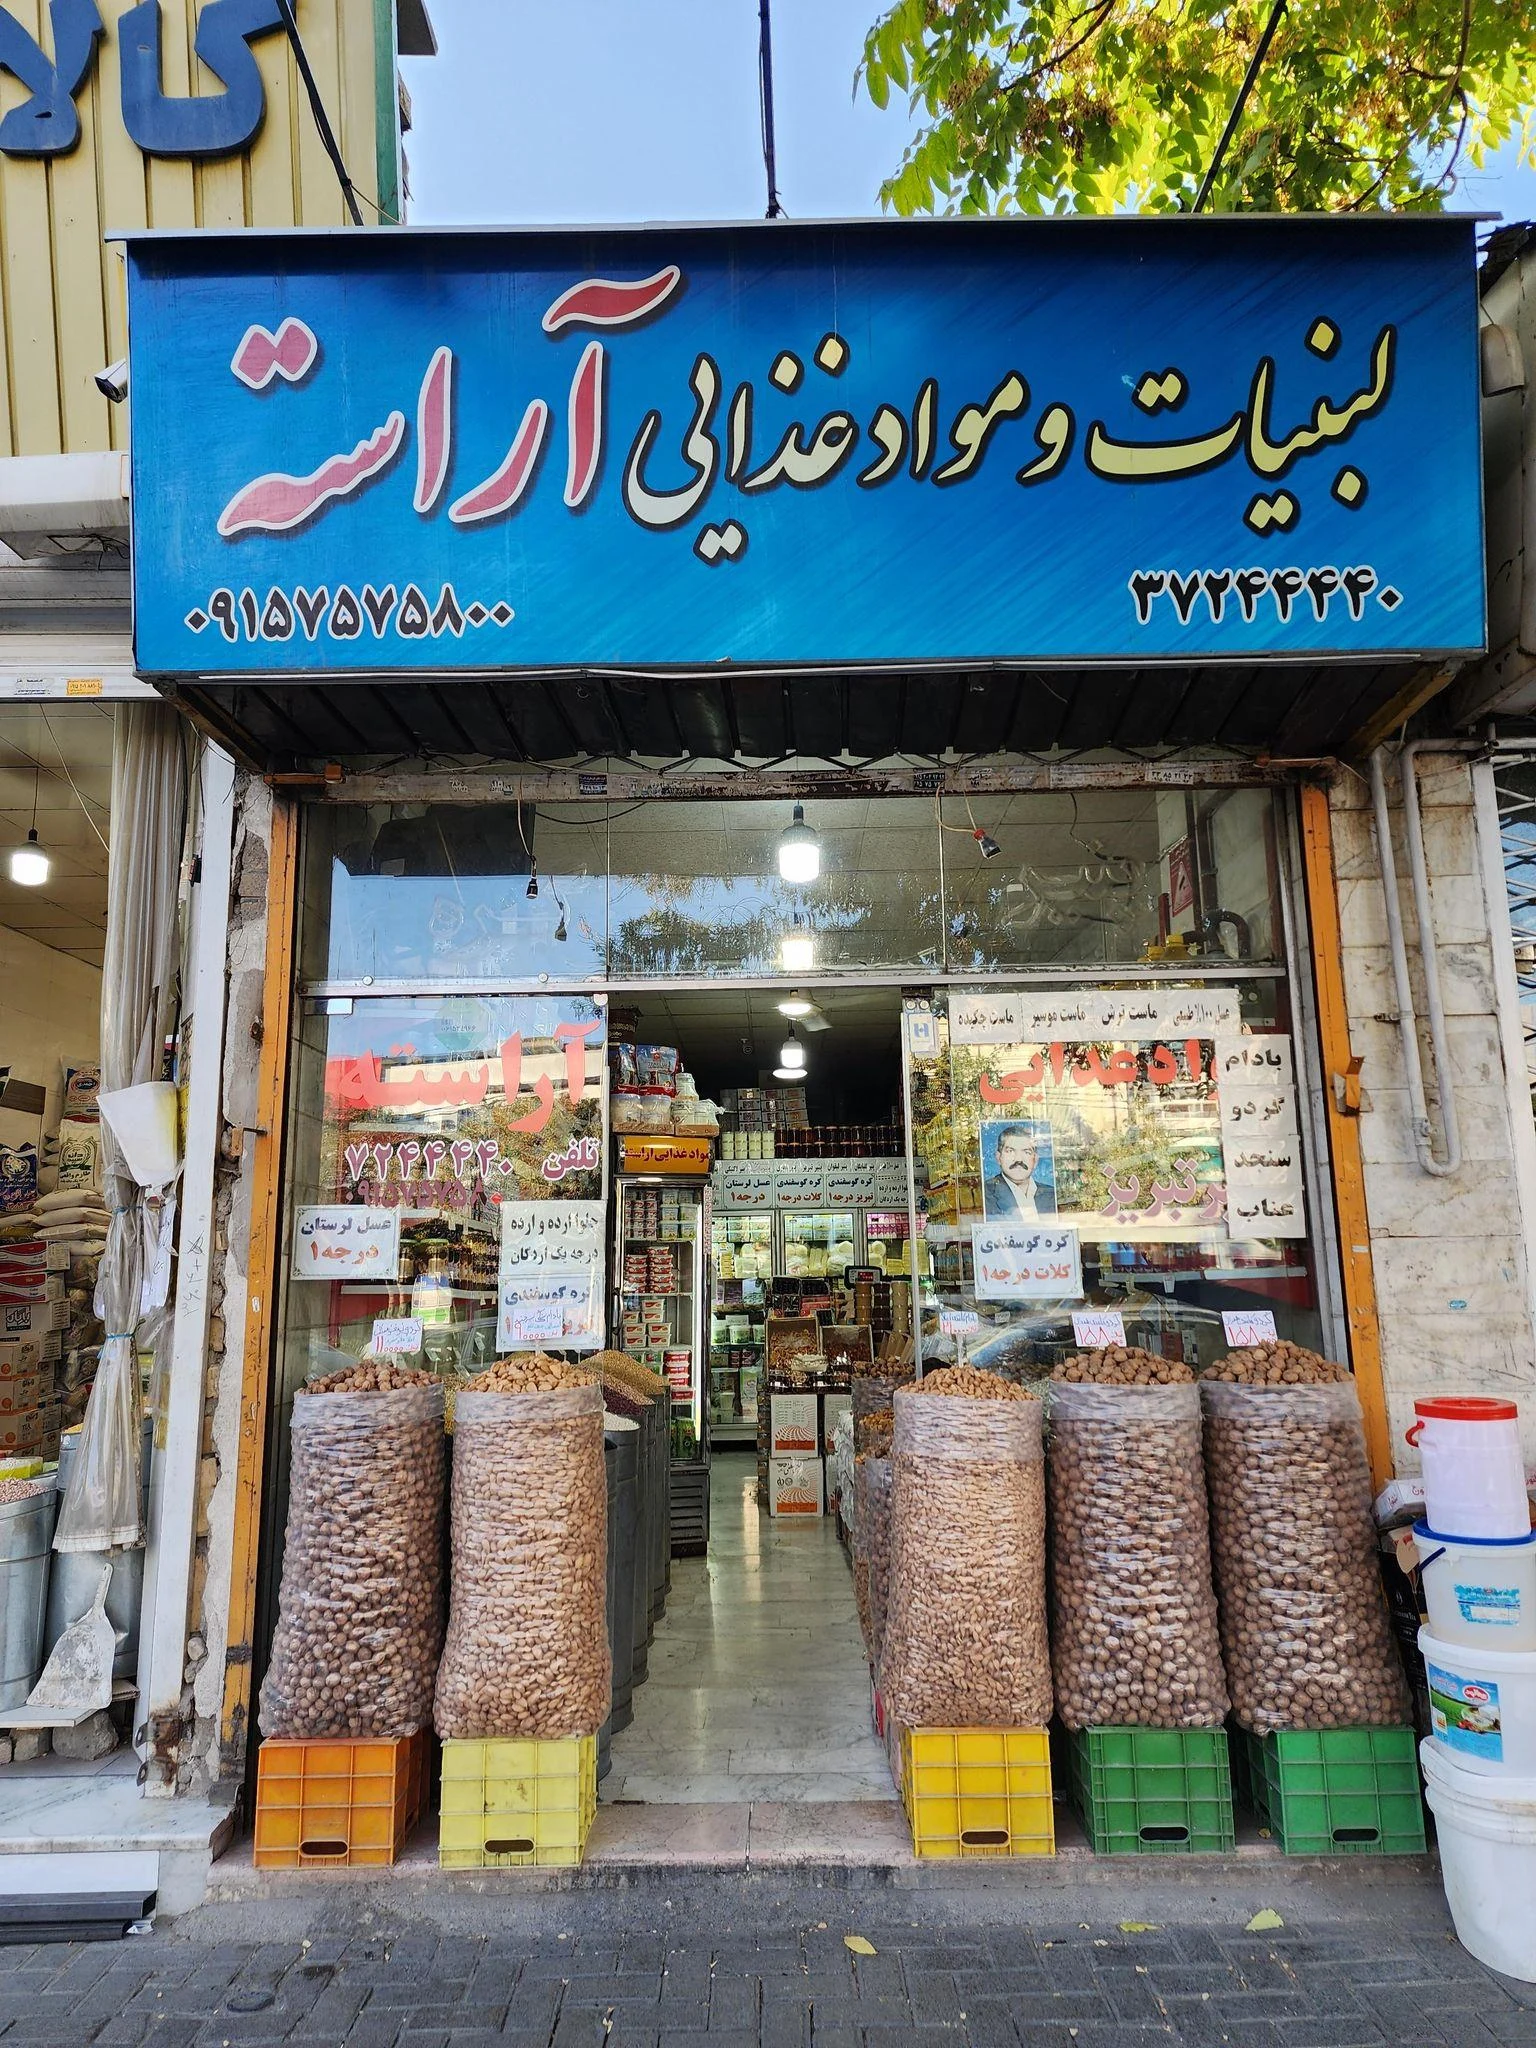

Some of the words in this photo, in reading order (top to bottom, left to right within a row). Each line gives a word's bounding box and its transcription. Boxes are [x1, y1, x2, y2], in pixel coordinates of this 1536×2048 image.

[857, 371, 1029, 487] مواد
[1086, 316, 1396, 537] لبنیات
[622, 332, 859, 566] غذایی
[1016, 402, 1073, 484] و
[1128, 565, 1403, 625] ۳۷۲۴۴۴۴۰
[184, 583, 515, 641] ۰۹۱۵۷۵۷۵۸۰۰
[990, 1008, 1013, 1025] ماست
[1060, 1004, 1085, 1021] ماست
[1102, 1004, 1125, 1025] ترش
[1129, 1003, 1157, 1020] ماست
[1225, 1049, 1282, 1071] بادام
[338, 1019, 600, 1132] آراسته
[1230, 1097, 1284, 1121] گردو
[345, 1139, 513, 1181] ۷۲۴۴۴۴۰
[541, 1136, 599, 1181] تلفن
[655, 1147, 688, 1161] غذایی
[688, 1149, 711, 1162] مواد
[1233, 1149, 1291, 1173] سنجد
[726, 1179, 751, 1188] لرستان
[754, 1179, 770, 1188] عسل
[1099, 1156, 1198, 1224] تبریز
[1236, 1198, 1294, 1218] عناب
[301, 1217, 352, 1235] لرستان
[357, 1216, 391, 1234] عسل
[538, 1220, 545, 1235] و
[980, 1234, 1041, 1254] گوسفندی
[1046, 1234, 1069, 1251] کره
[511, 1246, 548, 1265] اردکان
[551, 1246, 567, 1263] یک
[571, 1248, 598, 1264] درجه
[1035, 1263, 1071, 1279] کلات
[505, 1285, 567, 1305] گوسفندی
[1077, 1326, 1111, 1345] ۱۵۸
[1228, 1325, 1261, 1345] ۱۵۸
